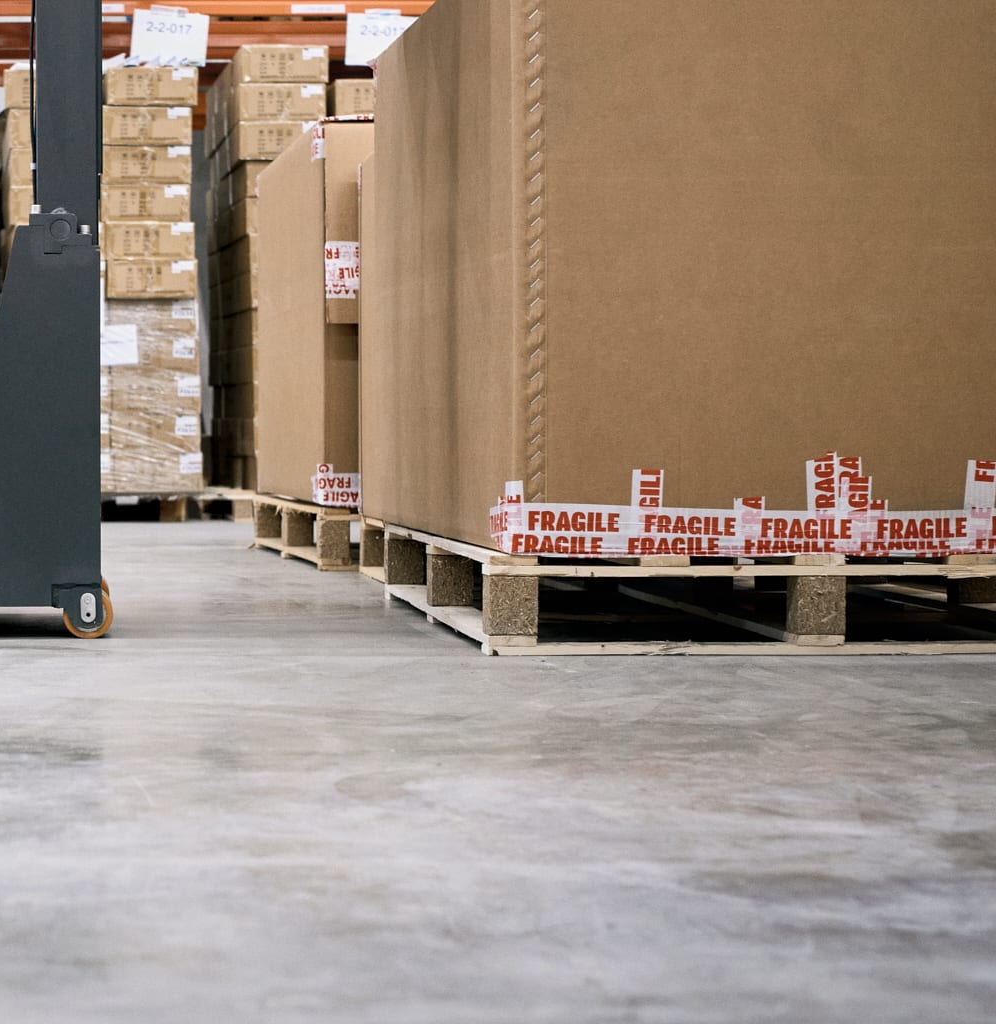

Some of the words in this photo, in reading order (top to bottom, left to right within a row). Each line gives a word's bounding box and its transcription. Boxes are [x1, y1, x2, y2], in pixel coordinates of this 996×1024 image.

[146, 21, 193, 35] 2-2-017
[528, 511, 620, 532] FRAGILE
[644, 514, 737, 536] FRAGILE
[761, 518, 853, 539] FRAGILE
[877, 517, 967, 539] FRAGILE
[512, 534, 603, 554] FRAGILE
[628, 537, 720, 555] FRAGILE
